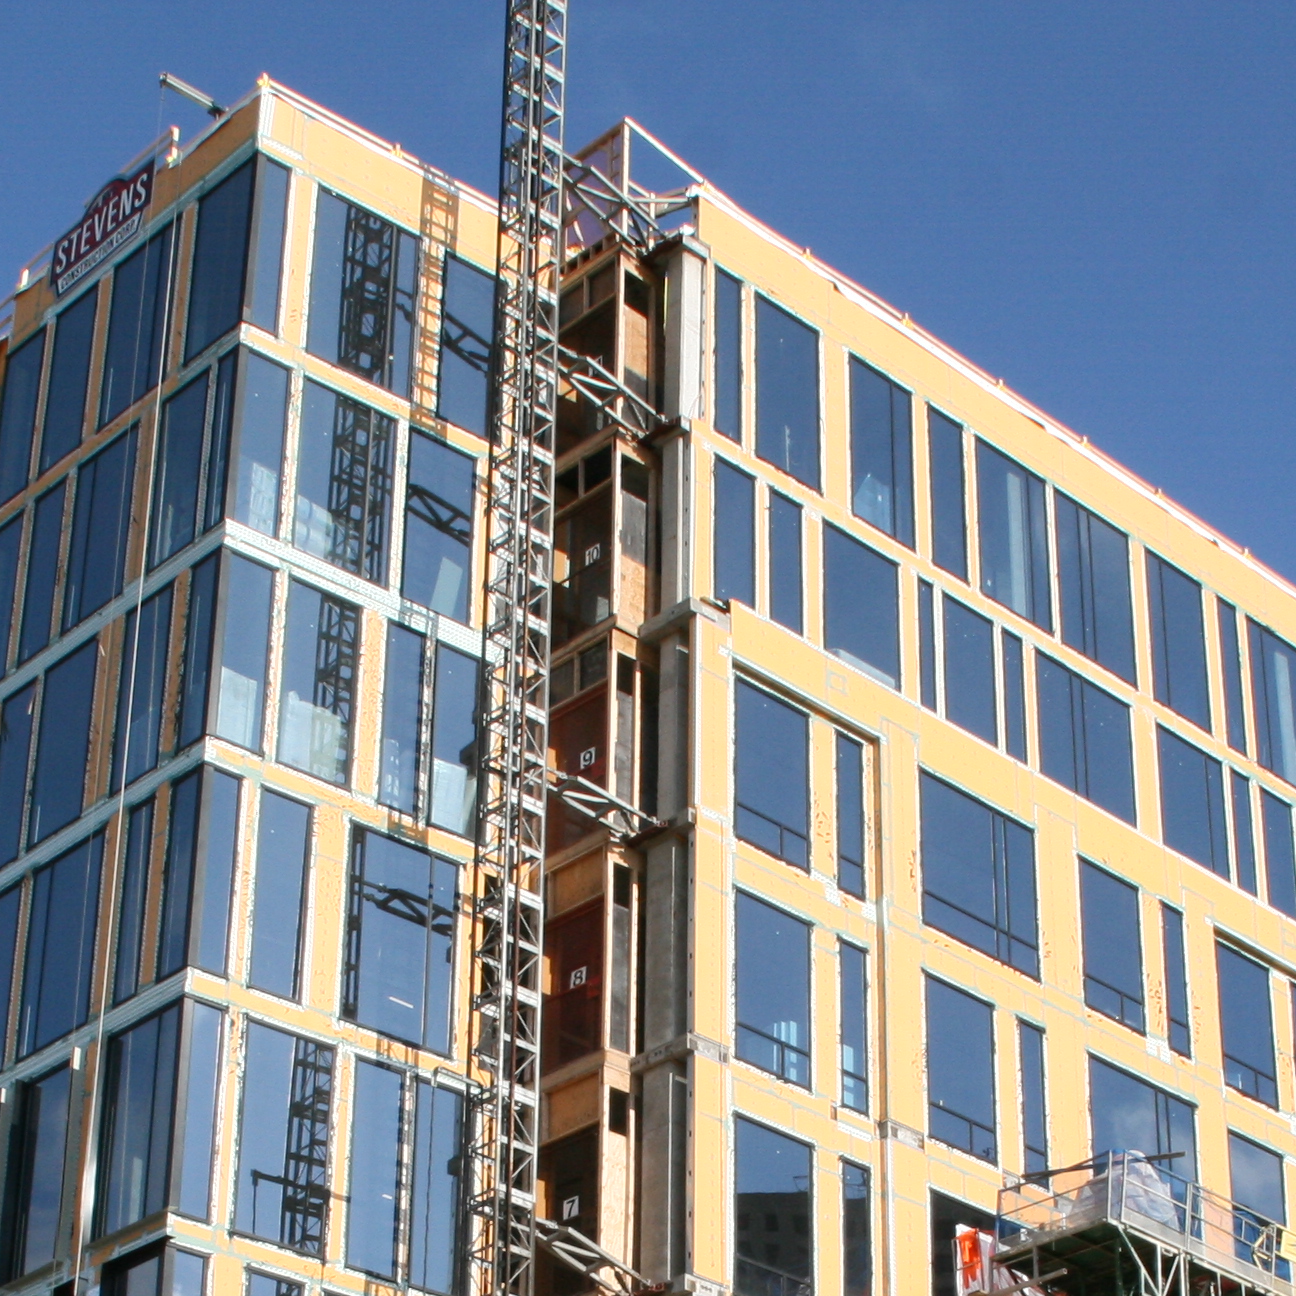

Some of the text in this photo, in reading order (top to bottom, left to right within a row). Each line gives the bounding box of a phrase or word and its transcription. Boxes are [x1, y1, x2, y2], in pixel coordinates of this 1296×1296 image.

[56, 173, 148, 273] STEVENS
[583, 750, 593, 767] 9
[573, 970, 584, 986] 8
[566, 1199, 576, 1217] 7
